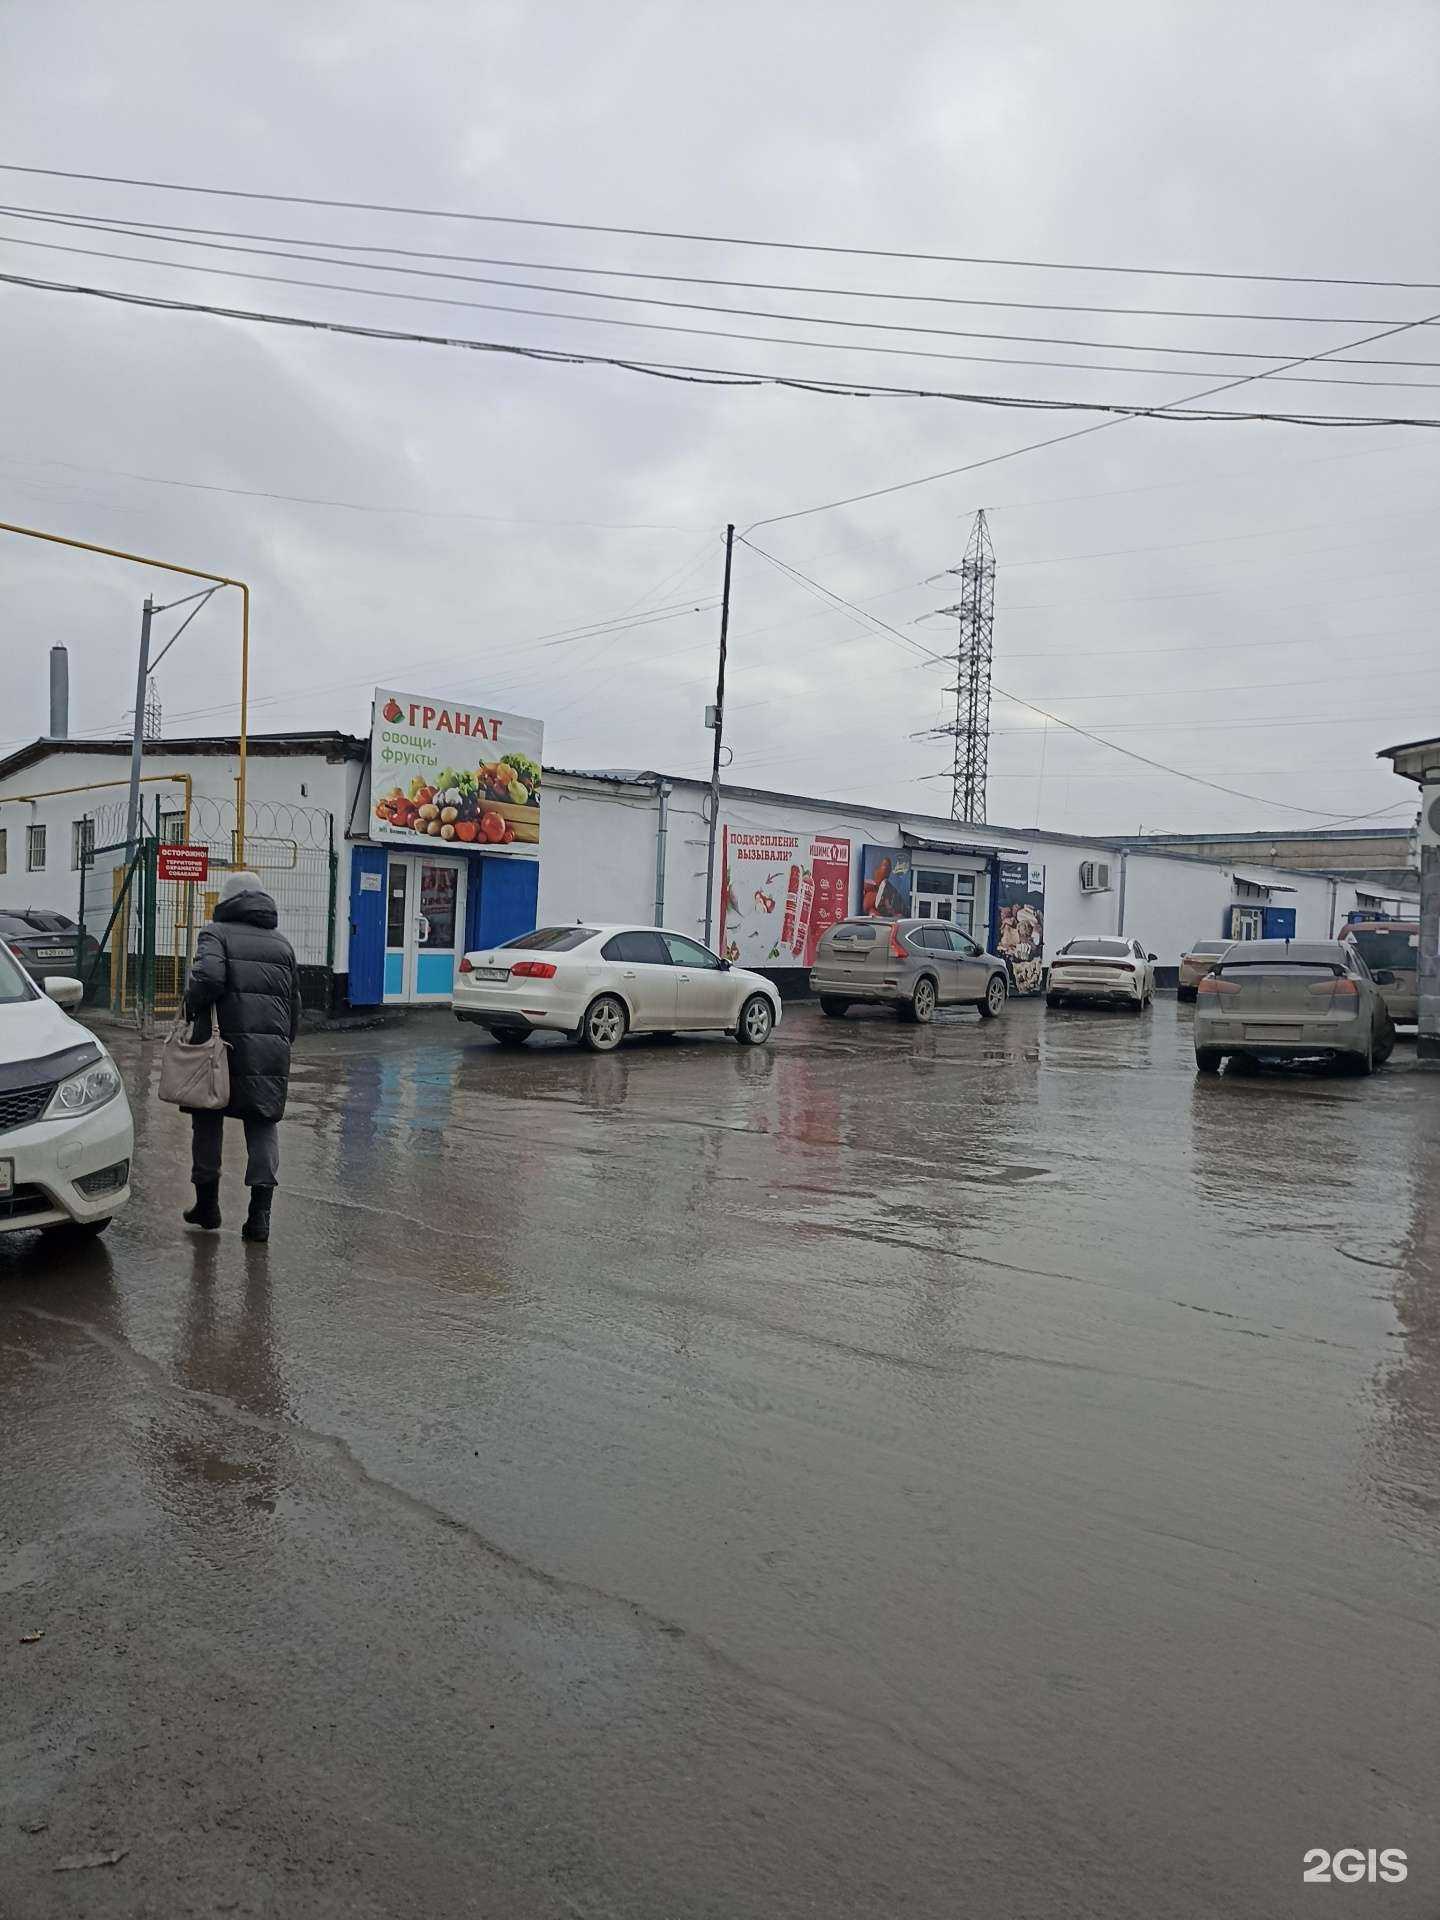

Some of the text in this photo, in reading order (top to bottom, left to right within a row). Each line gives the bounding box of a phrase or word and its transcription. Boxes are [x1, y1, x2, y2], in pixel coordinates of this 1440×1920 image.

[409, 703, 503, 741] ГРАНАТ
[382, 731, 437, 750] овощи-
[381, 747, 438, 766] фрукты
[730, 833, 799, 847] ПОДКРЕПЛЕНИЕ
[161, 849, 207, 858] ОСТОРОЖНО!
[737, 850, 792, 862] ВЫЗЫВАЛИ?
